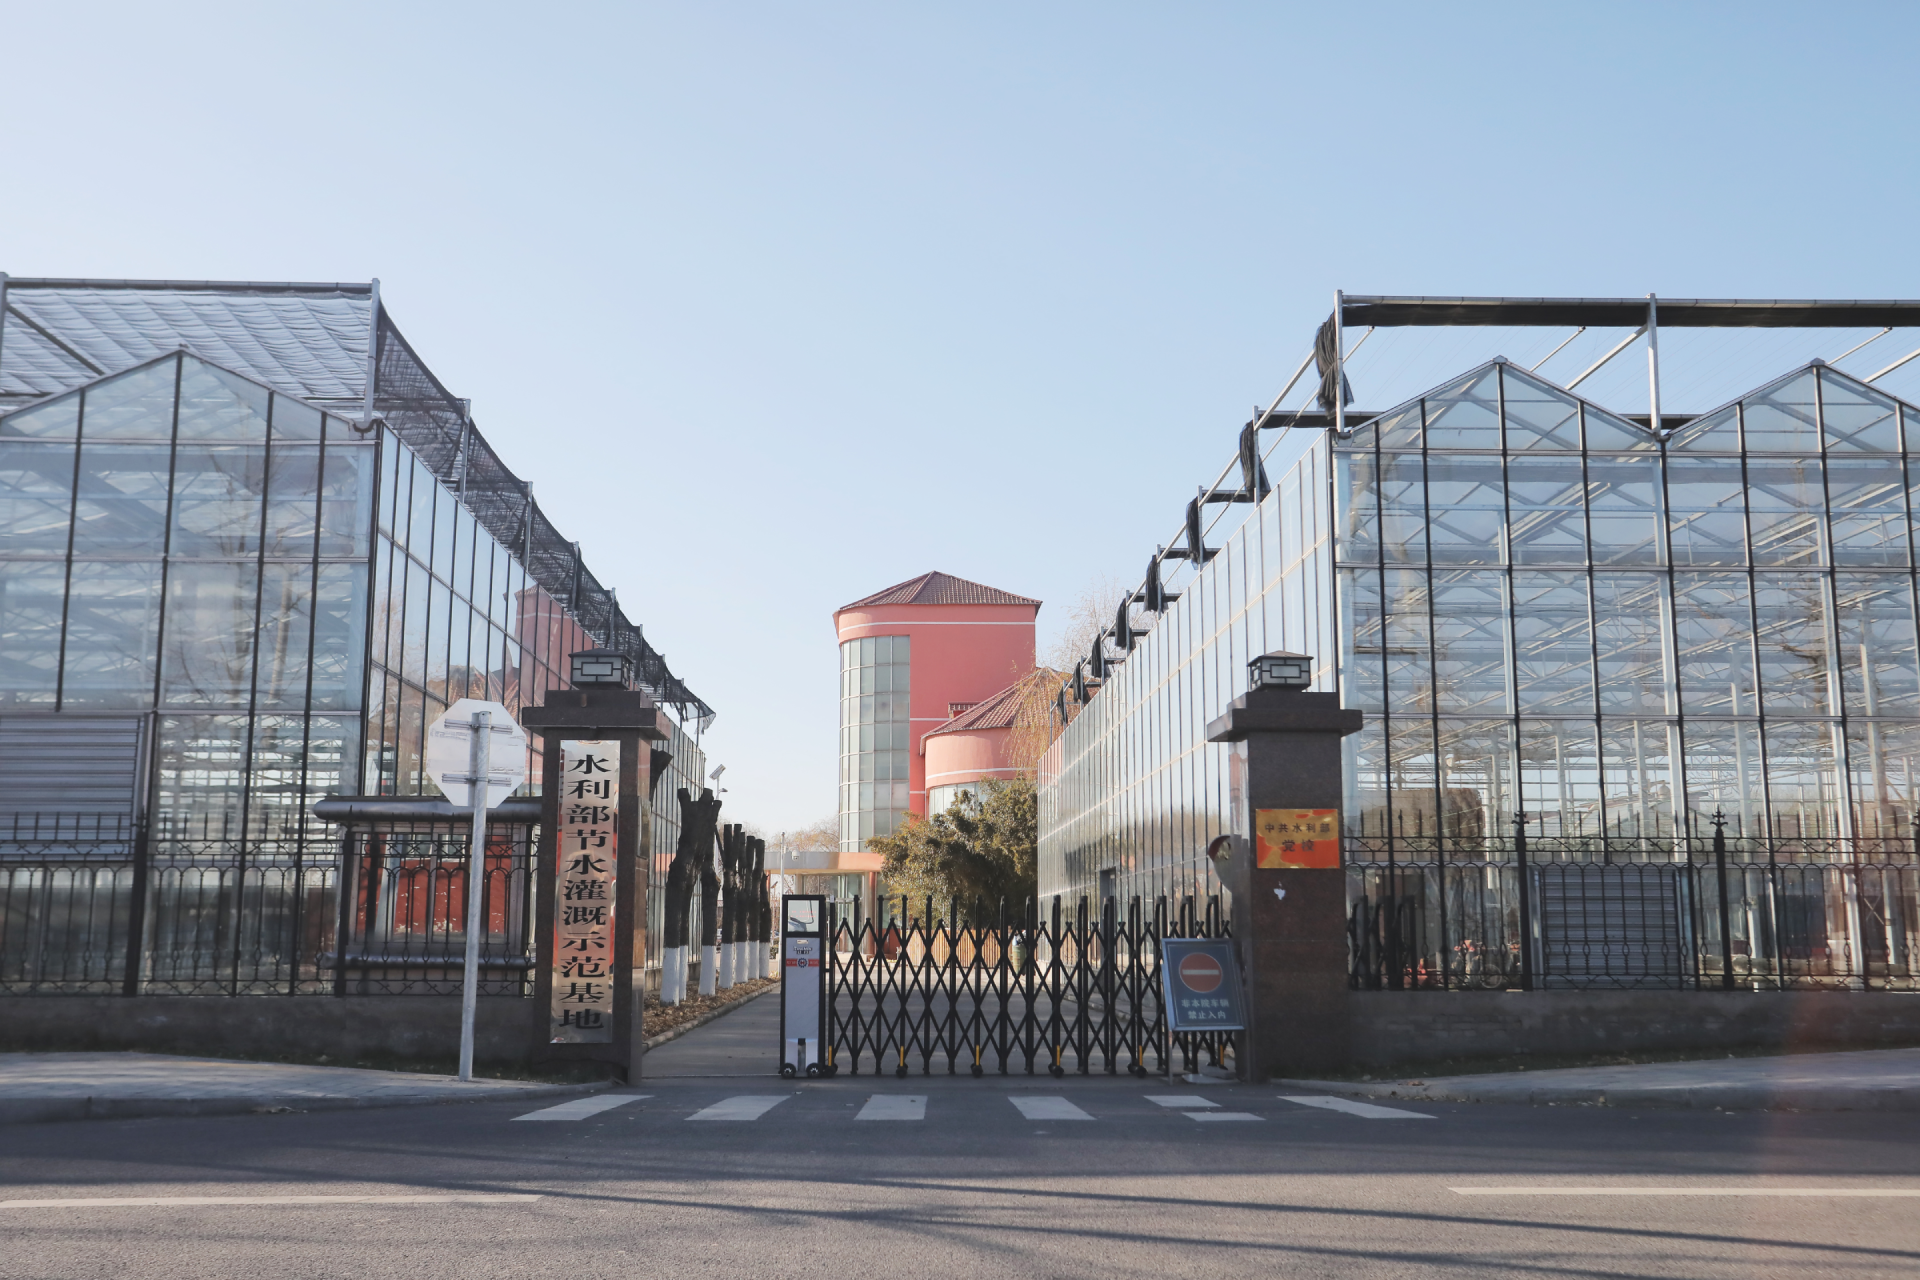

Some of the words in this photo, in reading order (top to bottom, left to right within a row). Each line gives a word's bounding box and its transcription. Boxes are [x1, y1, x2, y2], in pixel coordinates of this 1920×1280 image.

[1265, 823, 1331, 833] 中共水利部
[1281, 839, 1315, 852] 党校
[558, 754, 612, 1030] 水利部节水灌溉示范基地
[1187, 1010, 1227, 1020] 禁止入内
